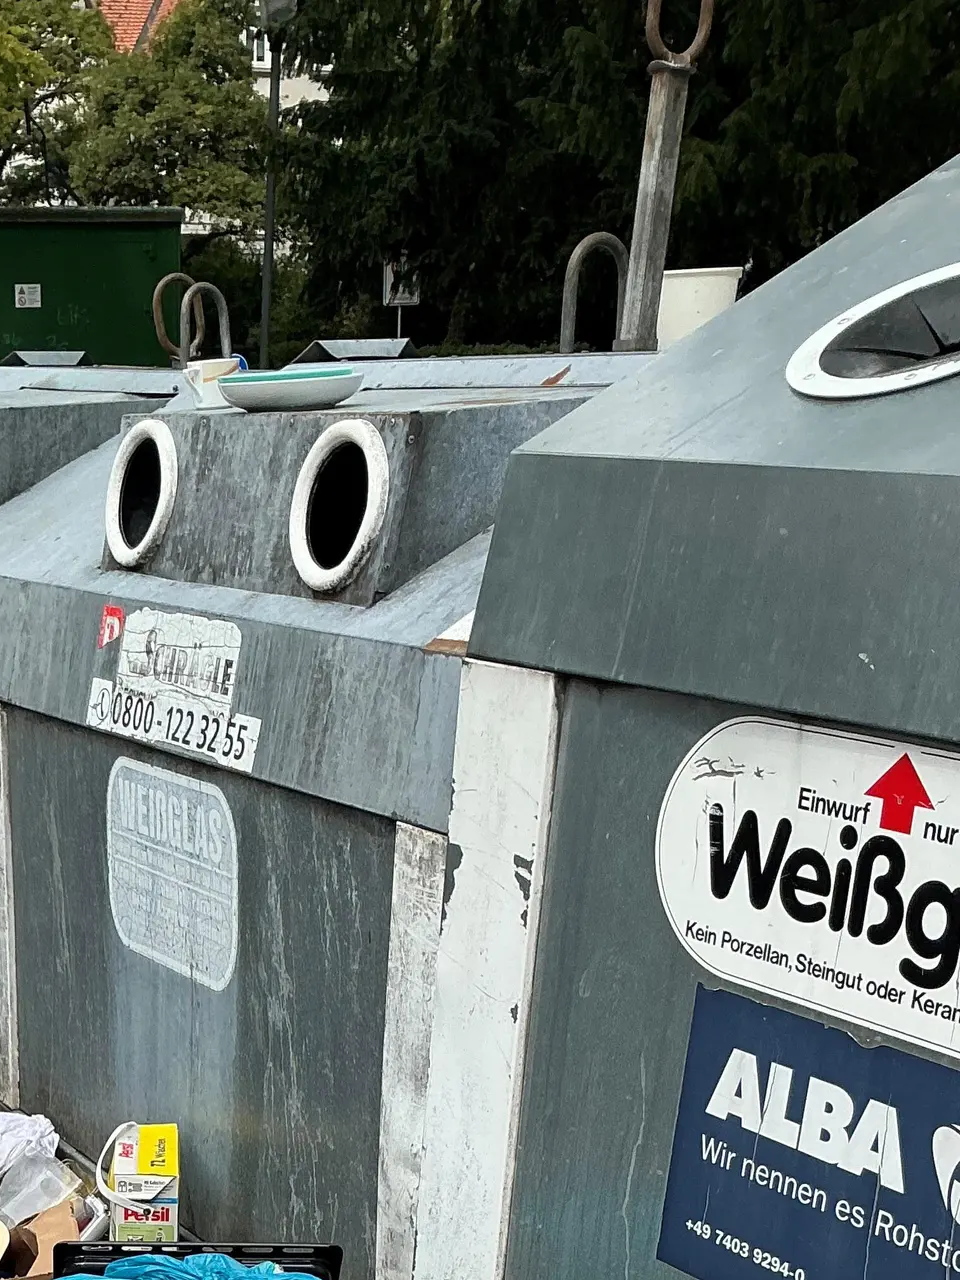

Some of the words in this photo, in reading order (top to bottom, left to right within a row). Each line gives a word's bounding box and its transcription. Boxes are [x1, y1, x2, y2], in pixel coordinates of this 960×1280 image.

[797, 786, 871, 825] Einwurf
[922, 821, 959, 846] nur
[685, 919, 717, 946] Kein
[721, 930, 792, 973] Porzellan,
[795, 953, 863, 993] Steingut
[866, 980, 906, 1005] oder
[704, 1047, 905, 1194] ALBA
[700, 1133, 737, 1171] Wir
[741, 1157, 827, 1213] nennen
[835, 1198, 866, 1229] es
[685, 1218, 711, 1240] +49
[715, 1229, 749, 1259] 7403
